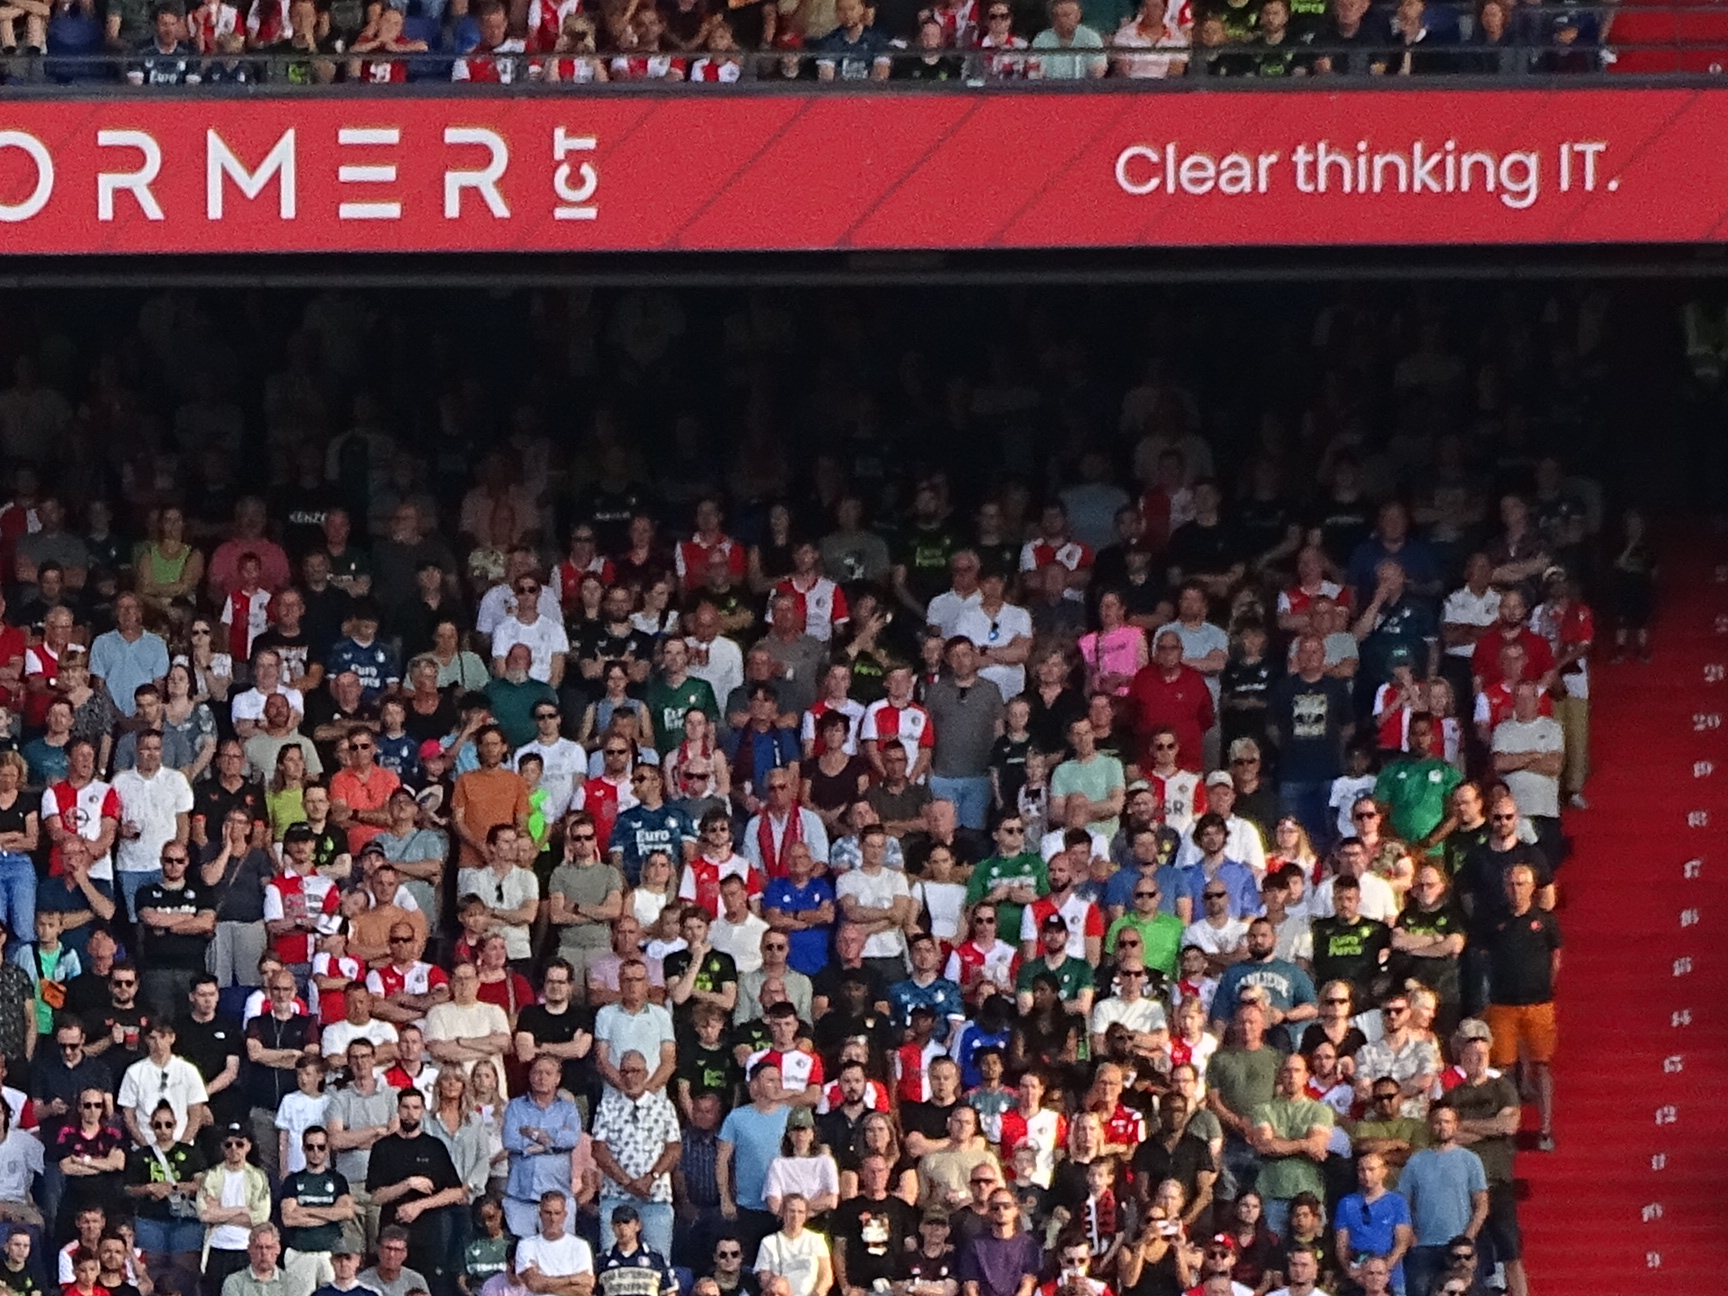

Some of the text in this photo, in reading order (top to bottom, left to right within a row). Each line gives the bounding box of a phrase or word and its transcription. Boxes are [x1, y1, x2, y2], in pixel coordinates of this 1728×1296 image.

[553, 125, 599, 220] ICT
[1115, 140, 1619, 210] Clear thinking IT.
